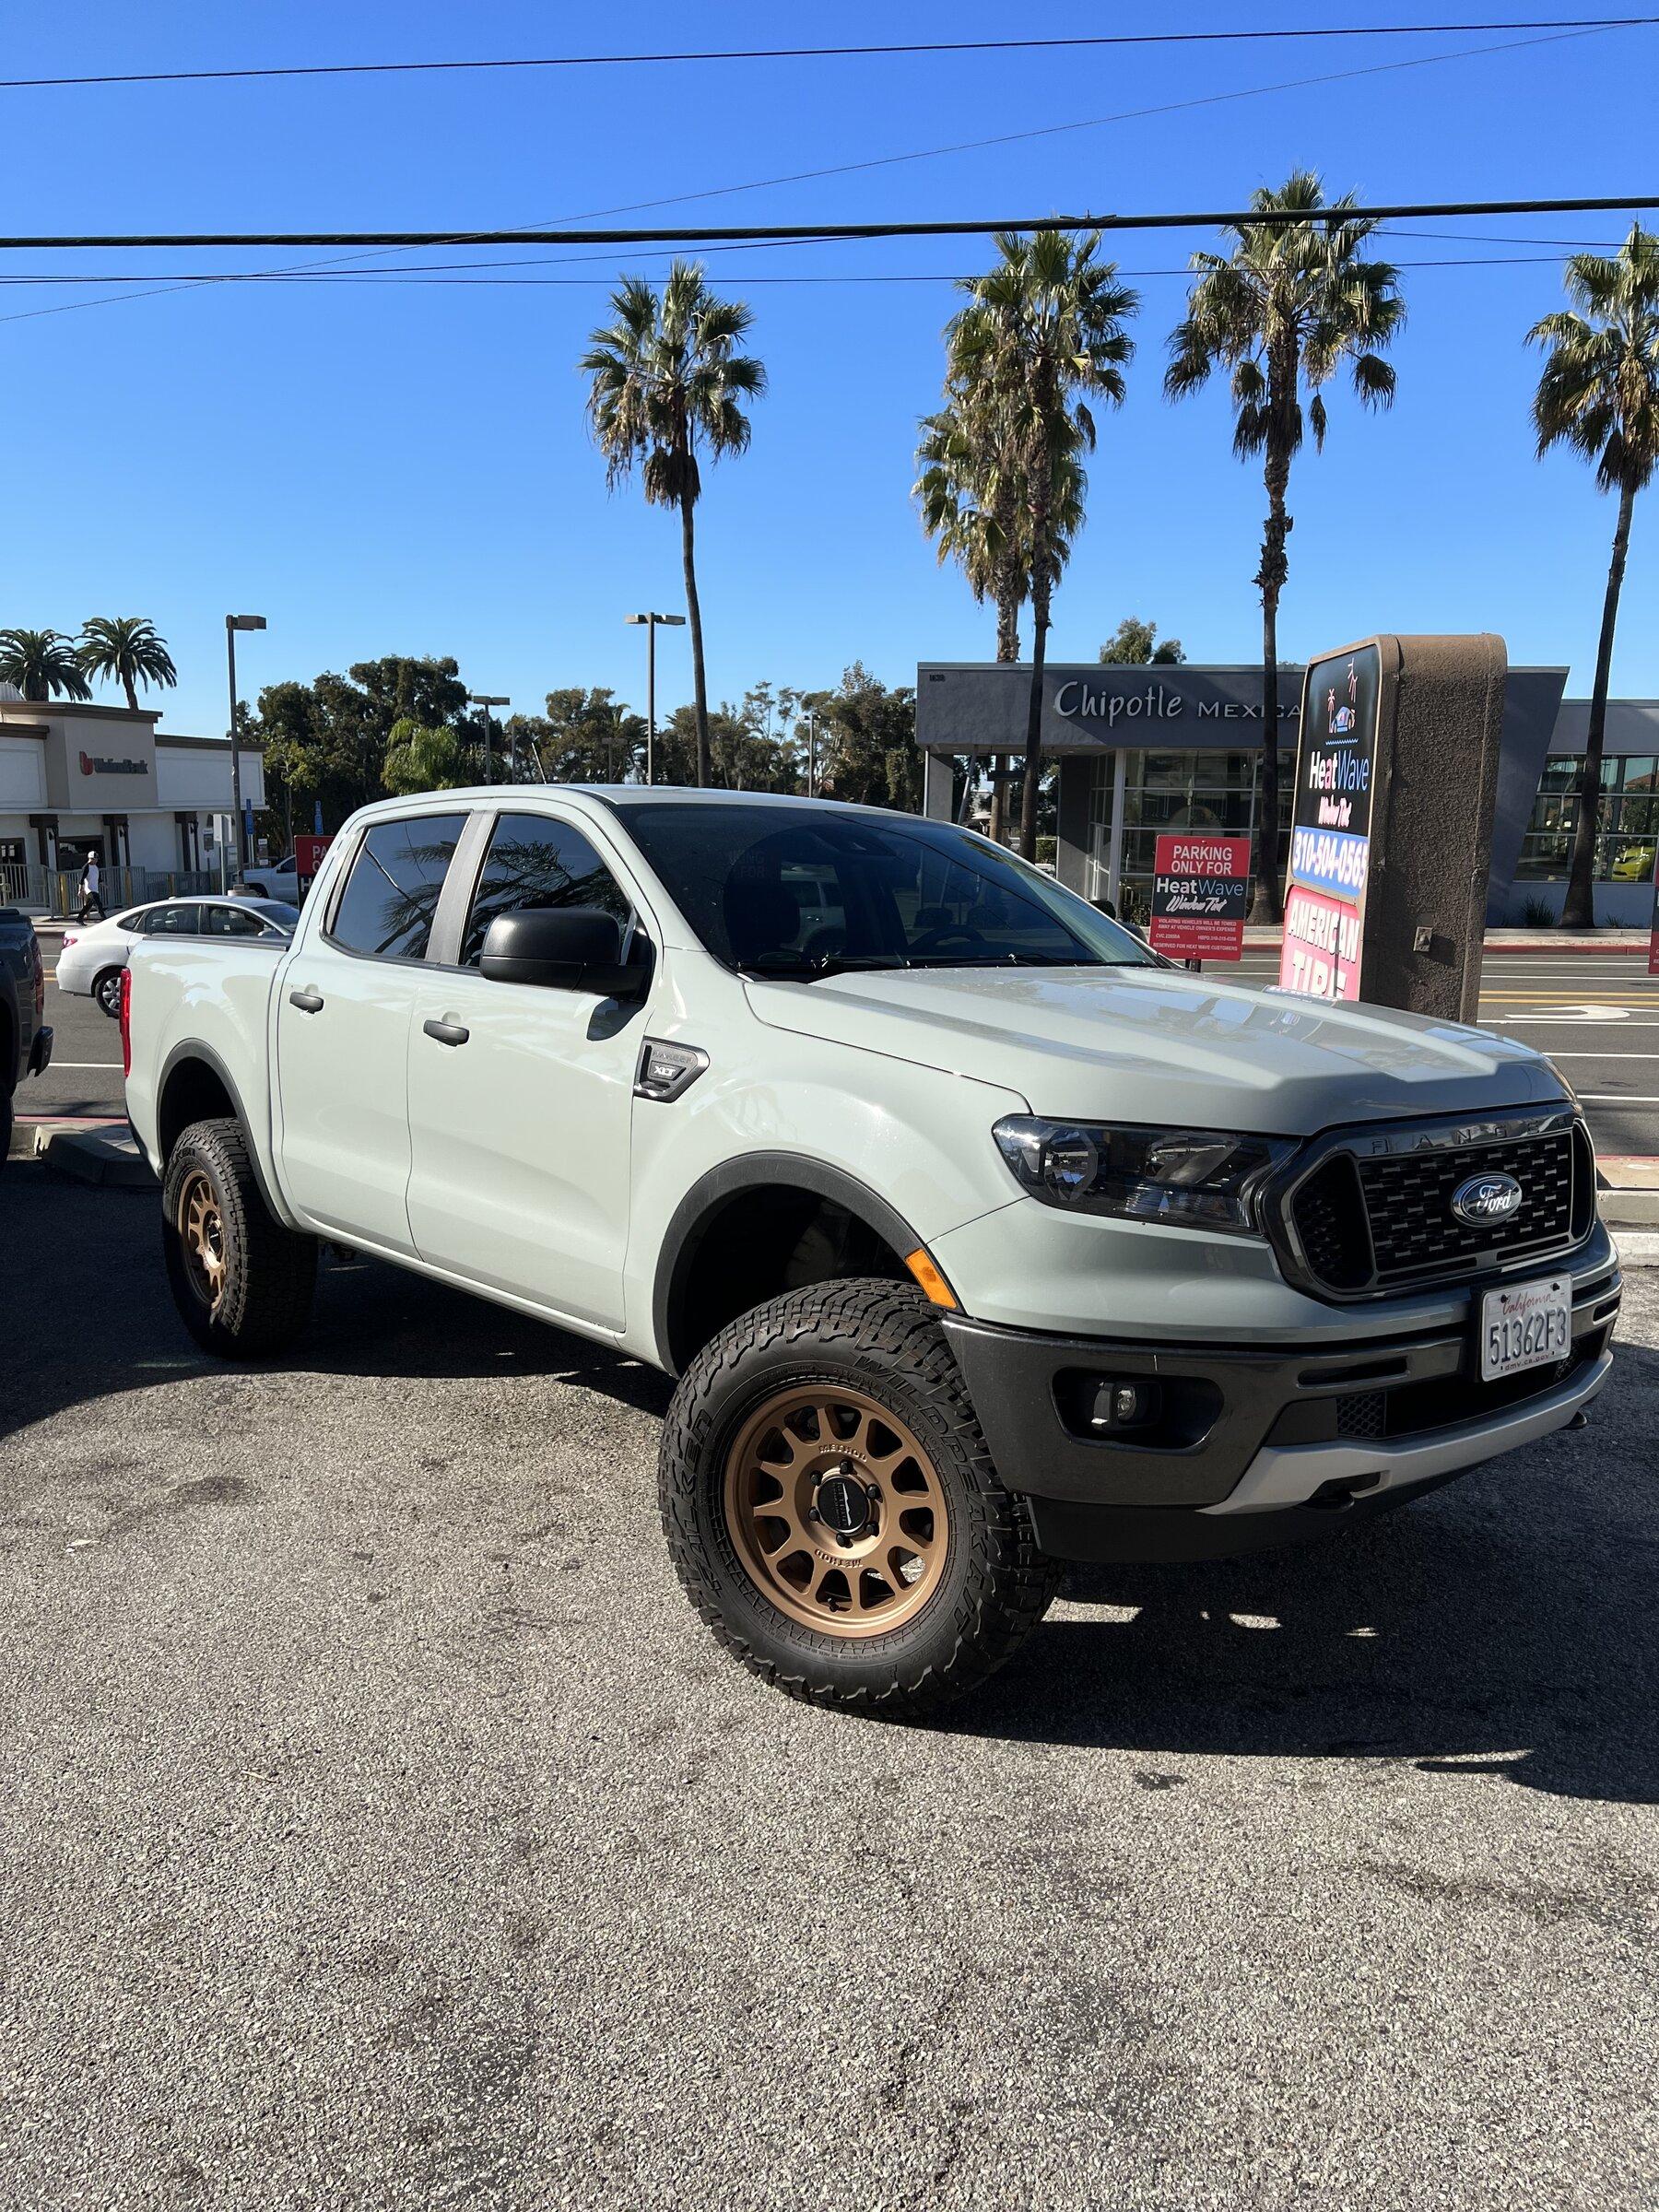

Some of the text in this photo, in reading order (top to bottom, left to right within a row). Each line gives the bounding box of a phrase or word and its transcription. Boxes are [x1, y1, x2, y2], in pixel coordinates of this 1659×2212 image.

[1053, 681, 1183, 727] Chipotle
[1172, 845, 1233, 861] PARKING
[1171, 860, 1232, 875] ONLY FOR
[1165, 894, 1228, 913] Window Tint
[1288, 899, 1360, 964] AMERICAN
[653, 1065, 677, 1077] XLT
[1477, 1184, 1512, 1214] Ford
[1502, 1291, 1556, 1317] California
[1489, 1307, 1568, 1366] 51362F3
[1504, 1354, 1549, 1371] dmv.ca.gov
[818, 1443, 868, 1463] METHOD
[853, 1356, 988, 1558] WILDPEAK
[814, 1548, 864, 1569] METHOD
